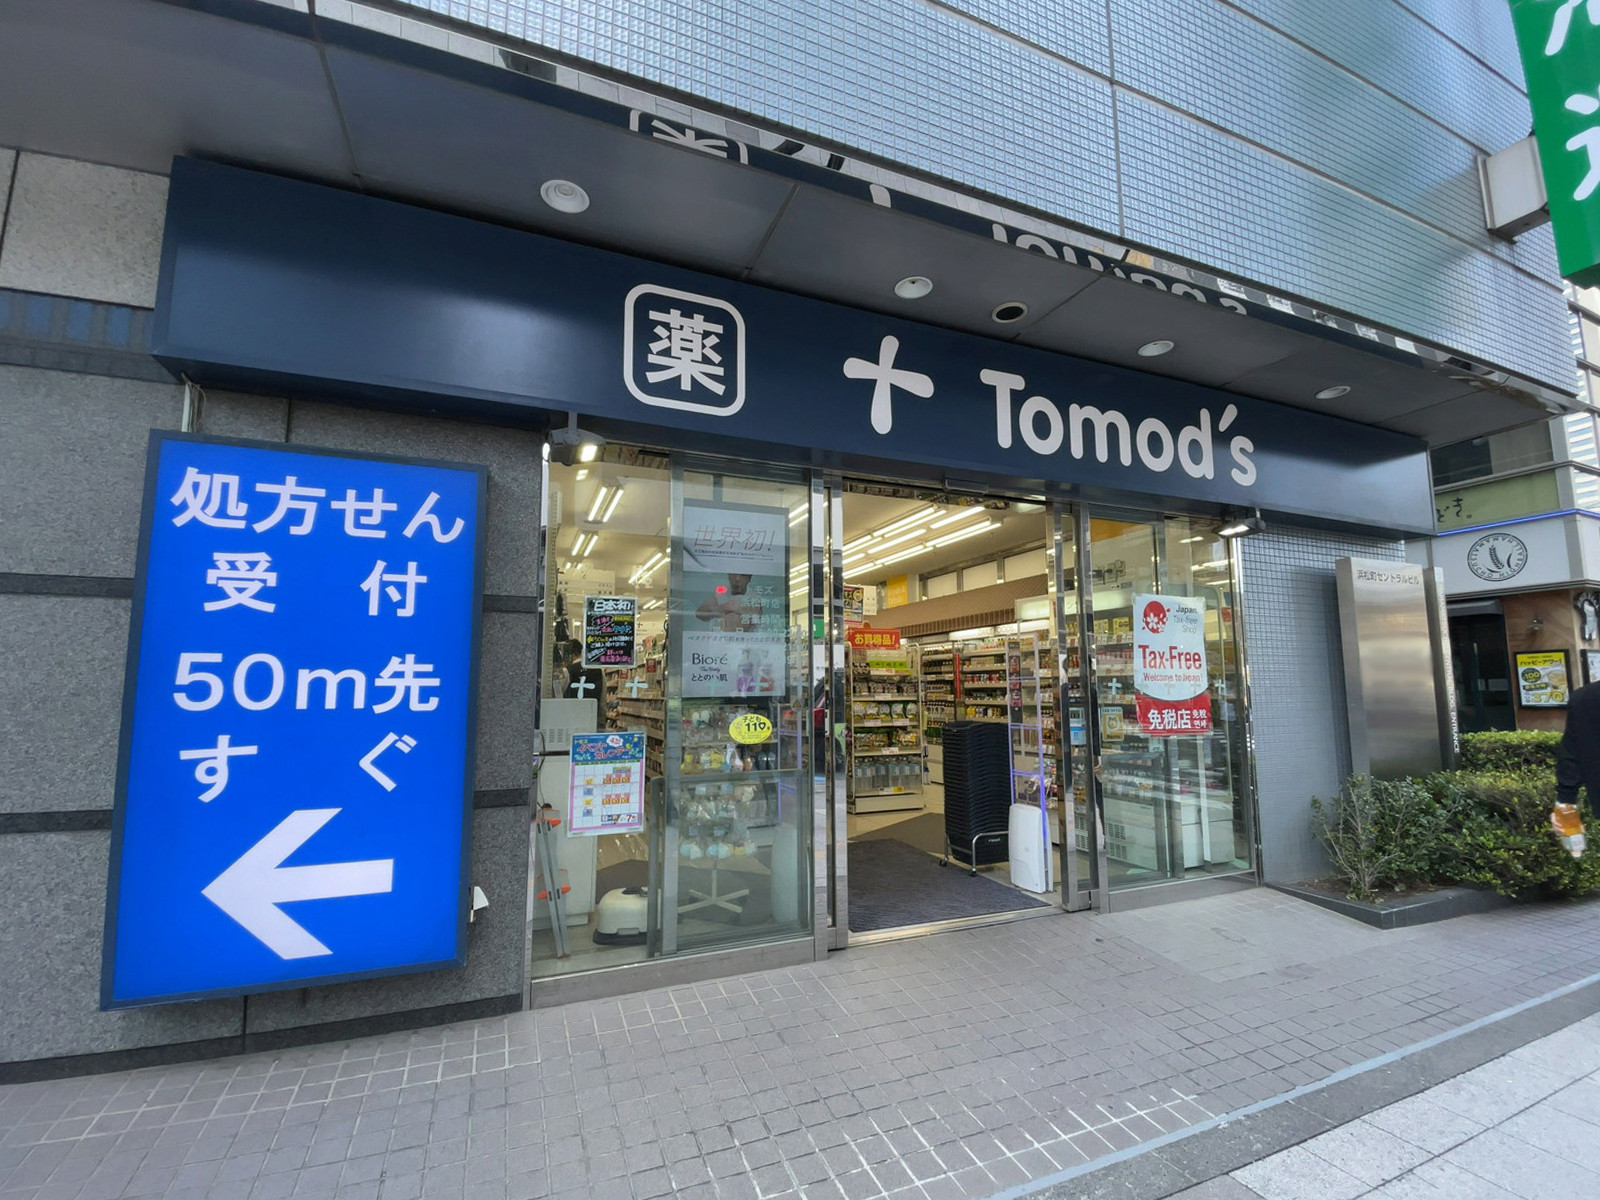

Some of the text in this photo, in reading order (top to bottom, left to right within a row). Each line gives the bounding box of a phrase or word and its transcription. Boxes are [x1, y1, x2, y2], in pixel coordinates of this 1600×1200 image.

[645, 308, 727, 397] 薬
[979, 367, 1257, 487] Tomod's
[170, 466, 466, 544] 処方せん
[172, 652, 442, 715] 50m先
[1138, 644, 1202, 670] Tax-Free
[1143, 672, 1174, 682] Welcome
[1148, 709, 1191, 730] 免税店
